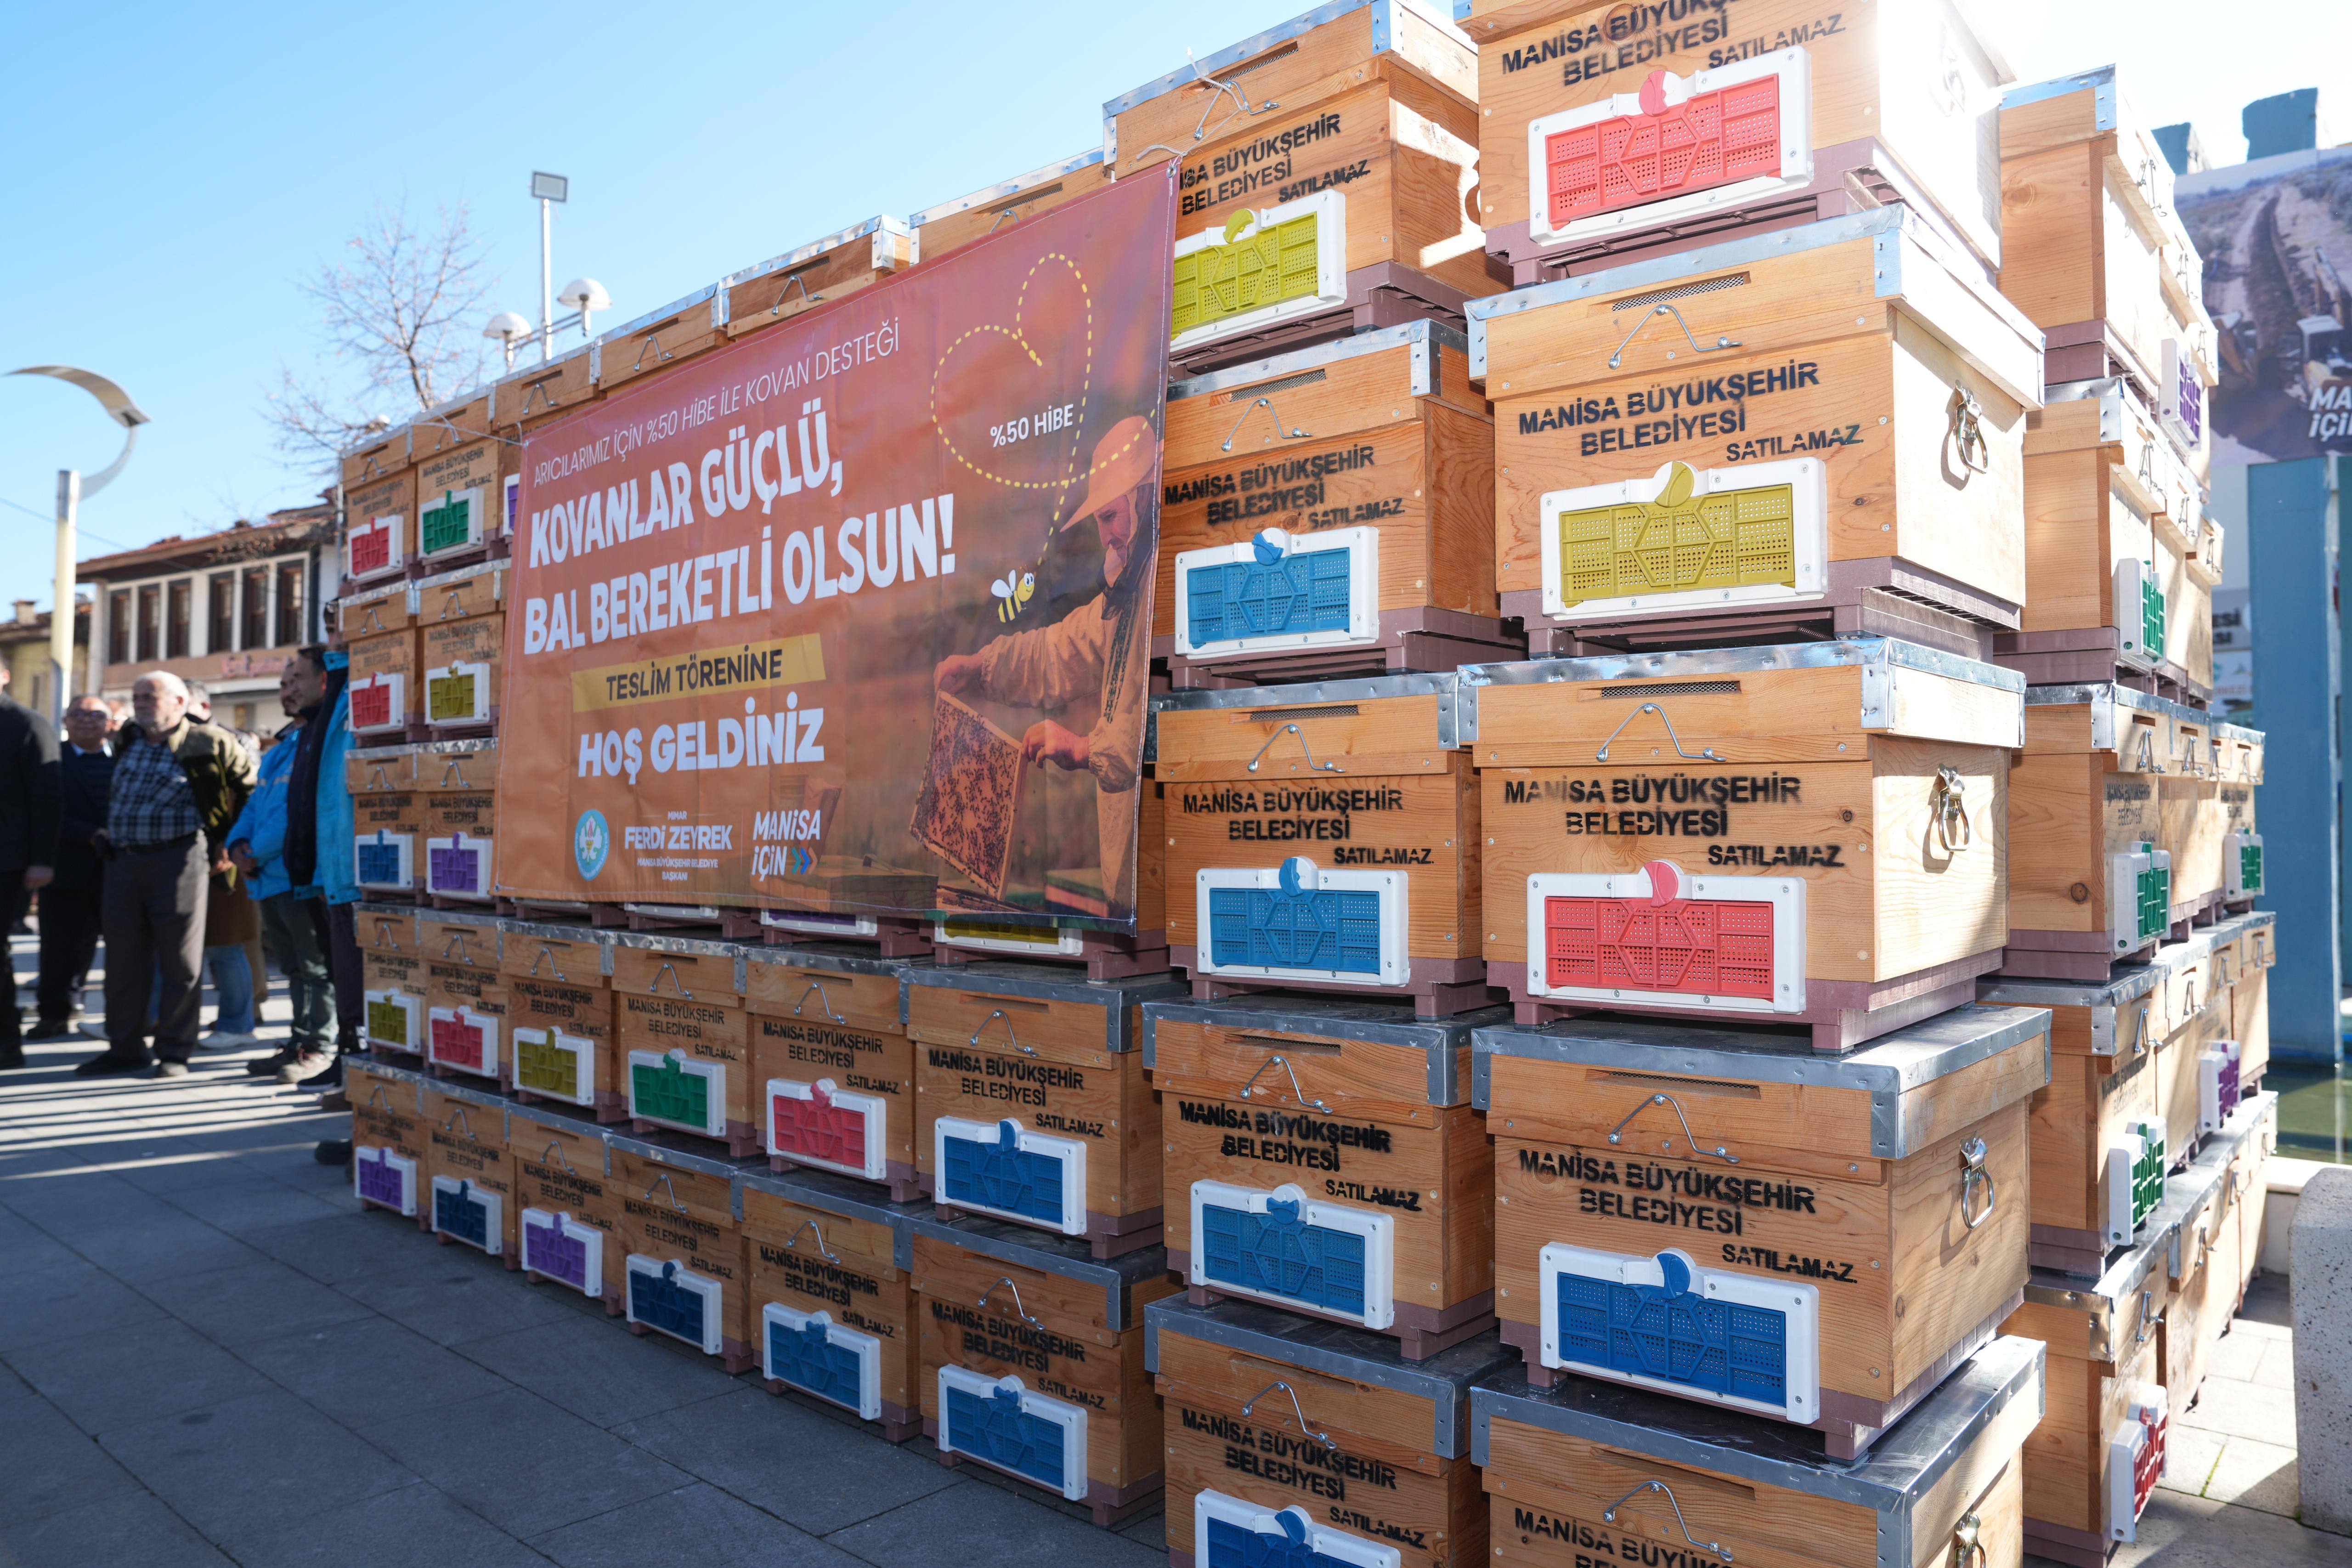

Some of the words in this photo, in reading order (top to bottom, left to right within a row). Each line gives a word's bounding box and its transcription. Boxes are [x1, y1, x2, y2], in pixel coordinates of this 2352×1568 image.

[1502, 24, 1603, 75] MANİSA
[1610, 0, 1744, 41] BÜYÜK
[1564, 9, 1728, 86] BELEDİYESİ
[1180, 164, 1209, 190] İSA
[1214, 113, 1341, 178] BÜYÜKŞEHİR
[1182, 156, 1292, 216] BELEDİYESİ
[533, 436, 611, 488] ARICILARIMIZ
[613, 423, 643, 461] İÇİN
[647, 410, 678, 444] %50
[682, 397, 715, 431] HİBE
[720, 385, 741, 417] İLE
[744, 357, 809, 408] KOVAN
[815, 317, 899, 380] DESTEĞİ
[1519, 397, 1620, 435] MANİSA
[1627, 359, 1820, 417] BÜYÜKŞEHİR
[990, 417, 1029, 447] %50
[1035, 404, 1074, 436] HİBE
[1581, 402, 1746, 457] BELEDİYESİ
[530, 461, 694, 569] KOVANLAR
[700, 396, 843, 518] GÜÇLÜ,
[1165, 473, 1236, 505] MANİSA
[1240, 444, 1375, 491] BÜYÜKŞEHİR
[1207, 480, 1325, 526] BELEDİYESİ
[524, 590, 585, 655] BAL
[591, 524, 773, 644] BEREKETLİ
[782, 493, 955, 605] OLSUN!
[606, 661, 671, 701] TESLİM
[676, 645, 782, 691] TÖRENİNE
[578, 728, 643, 785] HOŞ
[650, 691, 825, 773] GELDİNİZ
[1183, 788, 1258, 814] MANİSA
[1263, 784, 1403, 815] BÜYÜKŞEHİR
[1505, 776, 1606, 804] MANİSA
[1612, 771, 1801, 805] BÜYÜKŞEHİR
[625, 825, 666, 849] FERDİ
[667, 825, 733, 849] ZEYREK
[753, 809, 820, 840] MANİSA
[1229, 814, 1350, 840] BELEDİYESİ
[1566, 805, 1729, 836] BELEDİYESİ
[752, 845, 787, 881] İÇİN
[628, 997, 662, 1015] MANİSA
[663, 1001, 724, 1025] BÜYÜKŞEHİR
[649, 1019, 701, 1038] BELEDİYESİ
[763, 1021, 805, 1041] MANİSA
[808, 1026, 883, 1054] BÜYÜKŞEHİR
[789, 1045, 854, 1069] BELEDİYESİ
[929, 1049, 982, 1075] MANİSA
[986, 1057, 1084, 1090] BÜYÜKŞEHİR
[962, 1077, 1046, 1106] BELEDİYESİ
[1179, 1101, 1252, 1132] MANİSA
[1255, 1111, 1392, 1153] BÜYÜKŞEHİR
[1221, 1135, 1340, 1172] BELEDİYESİ
[1520, 1149, 1619, 1184] MANİSA
[1626, 1162, 1816, 1213] BÜYÜKŞEHİR
[625, 1200, 657, 1220] MANİSA
[1580, 1188, 1741, 1236] BELEDİYESİ
[645, 1223, 697, 1252] BELEDİYESİ
[760, 1245, 801, 1272] MANİSA
[803, 1259, 878, 1296] BÜYÜKŞEHİR
[785, 1272, 850, 1307] BELEDİYESİ
[932, 1301, 985, 1332] MANİSA
[988, 1318, 1086, 1362] BÜYÜKŞEHİR
[965, 1332, 1049, 1373] BELEDİYESİ
[1182, 1408, 1255, 1446] MANİSA
[1260, 1429, 1396, 1489] BÜYÜKŞEHİR
[1225, 1446, 1345, 1501] BELEDİYESİ
[1515, 1507, 1614, 1555] MANİSA
